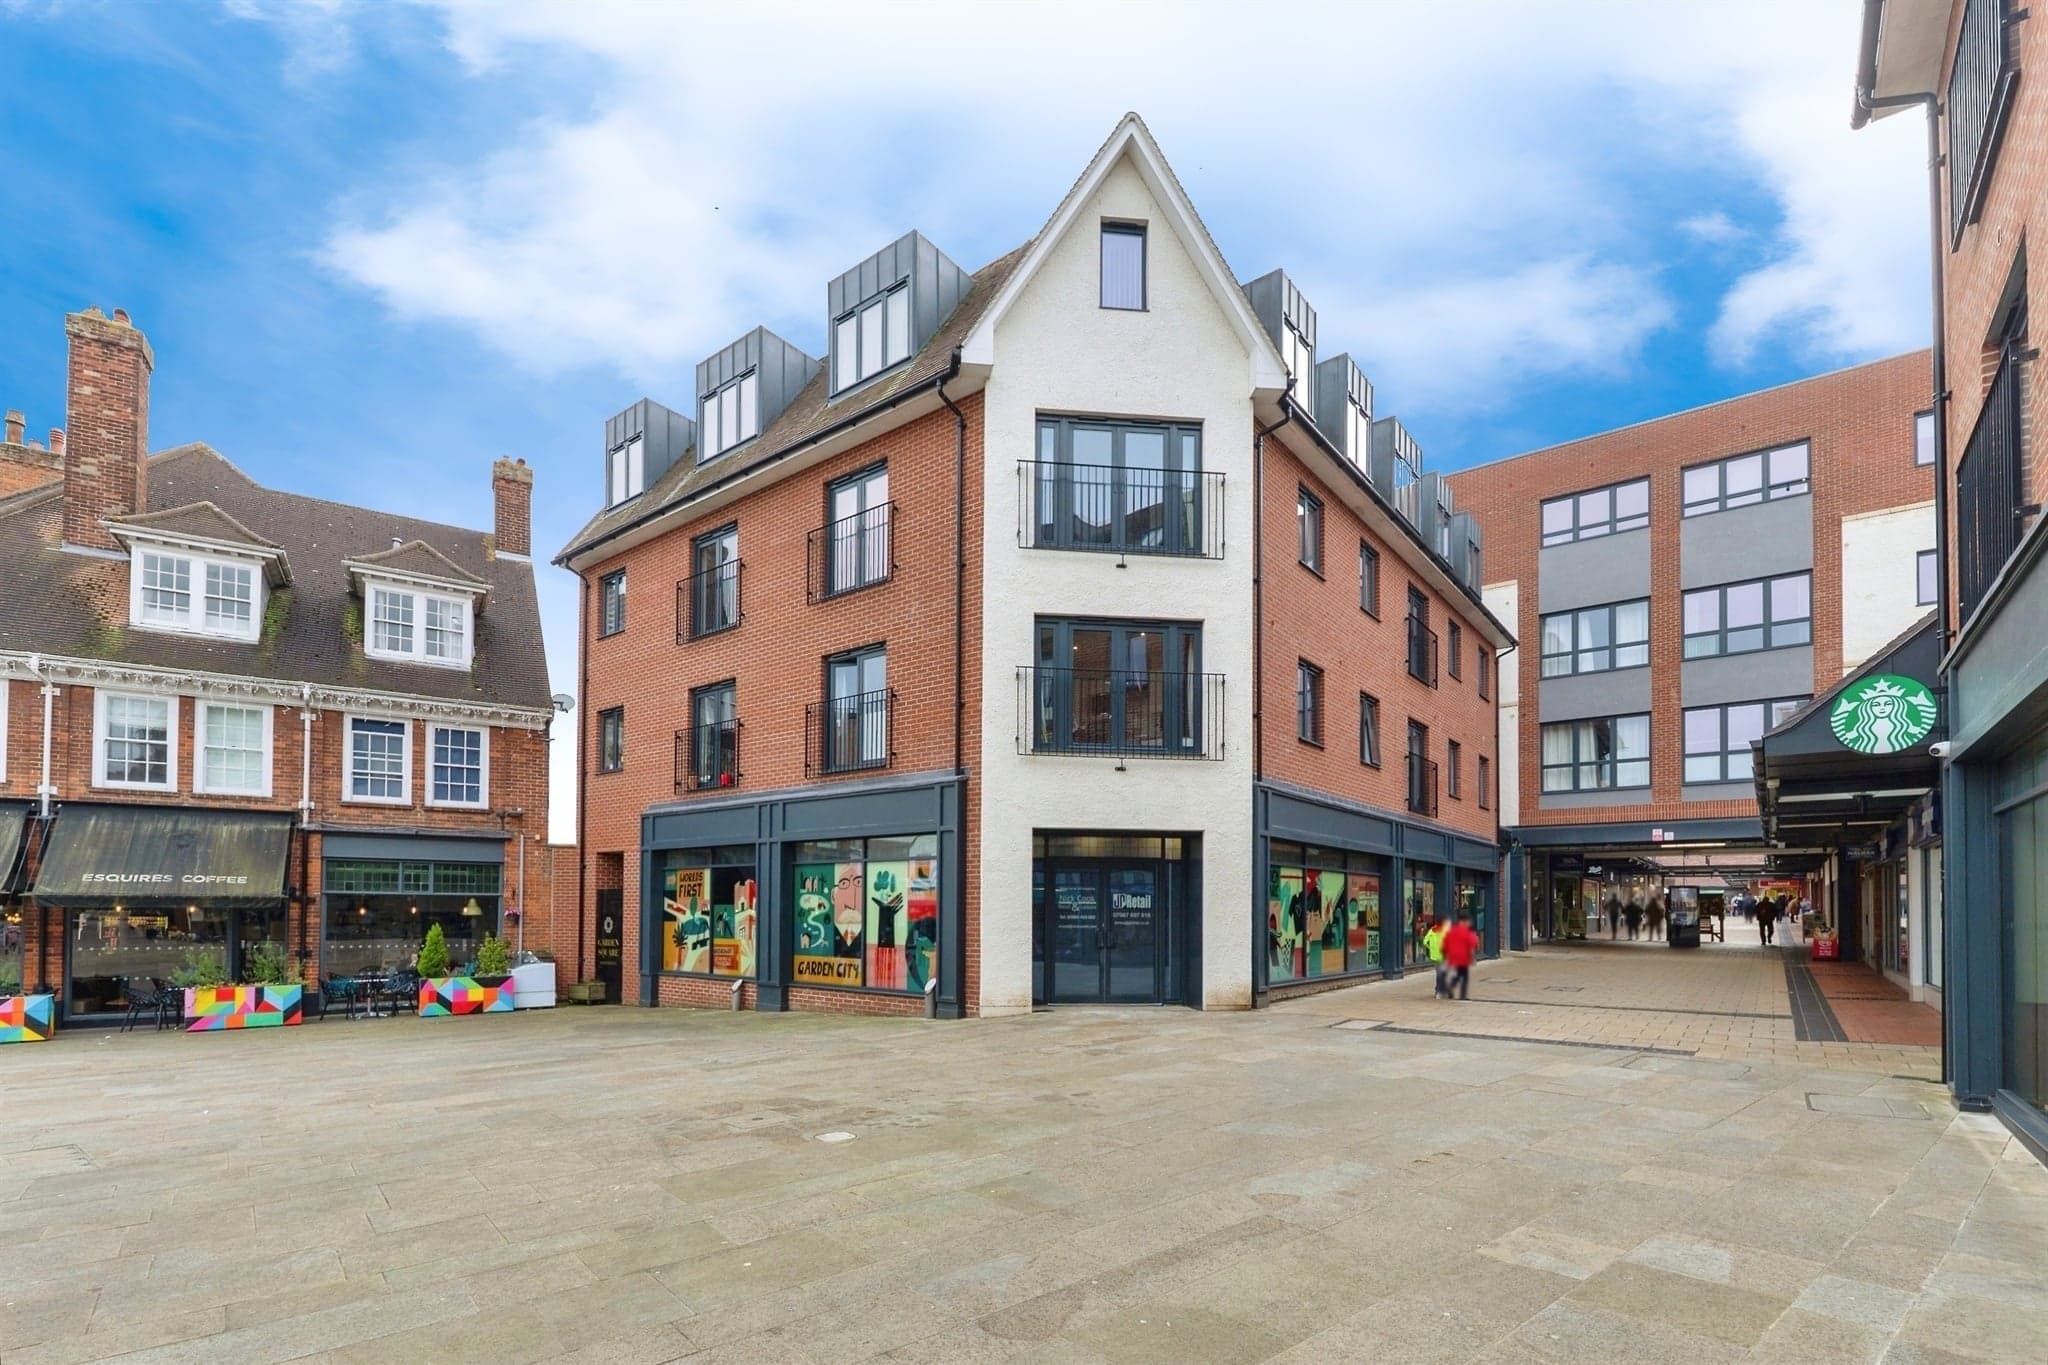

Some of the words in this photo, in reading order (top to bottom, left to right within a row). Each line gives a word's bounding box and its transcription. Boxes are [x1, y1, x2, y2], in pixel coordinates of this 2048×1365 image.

[81, 873, 173, 883] ESQUIRES
[181, 874, 248, 884] COFFEE
[679, 883, 702, 897] FIRST
[798, 961, 835, 977] GARDEN
[836, 963, 860, 979] CITY
